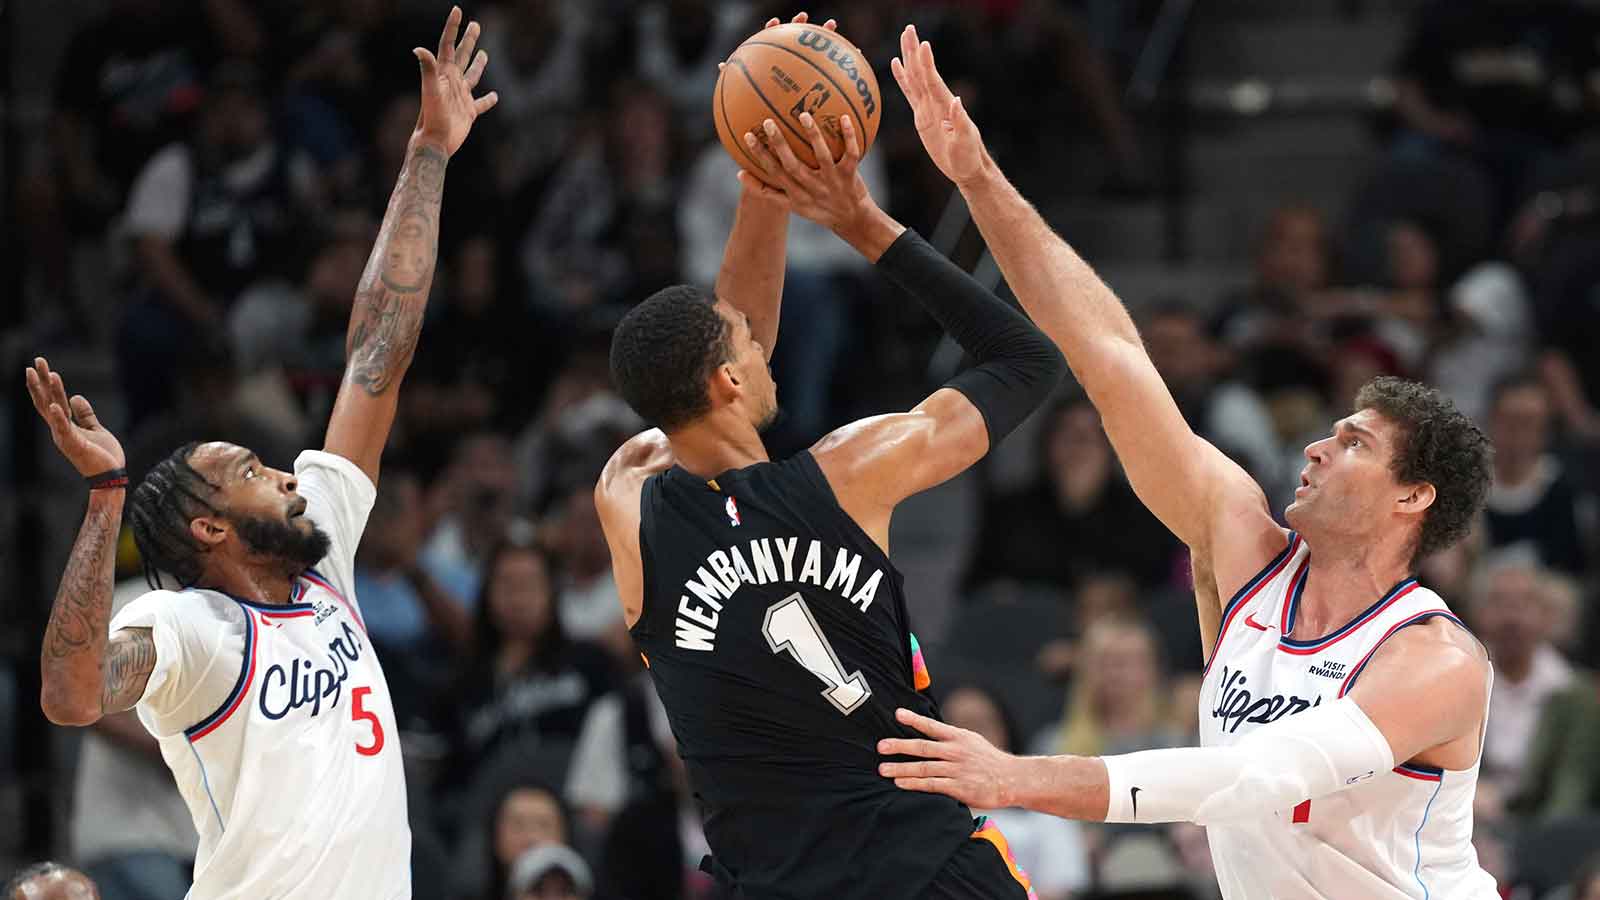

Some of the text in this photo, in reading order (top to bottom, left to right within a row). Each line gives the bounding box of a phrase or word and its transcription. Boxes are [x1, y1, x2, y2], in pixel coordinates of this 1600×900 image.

[798, 31, 876, 118] Wilson
[674, 536, 884, 652] WEMBANYAMA
[259, 621, 362, 720] Cliprs
[761, 592, 873, 716] 1
[1323, 660, 1346, 671] VISIT
[351, 686, 385, 756] 5
[1213, 665, 1322, 733] lipper
